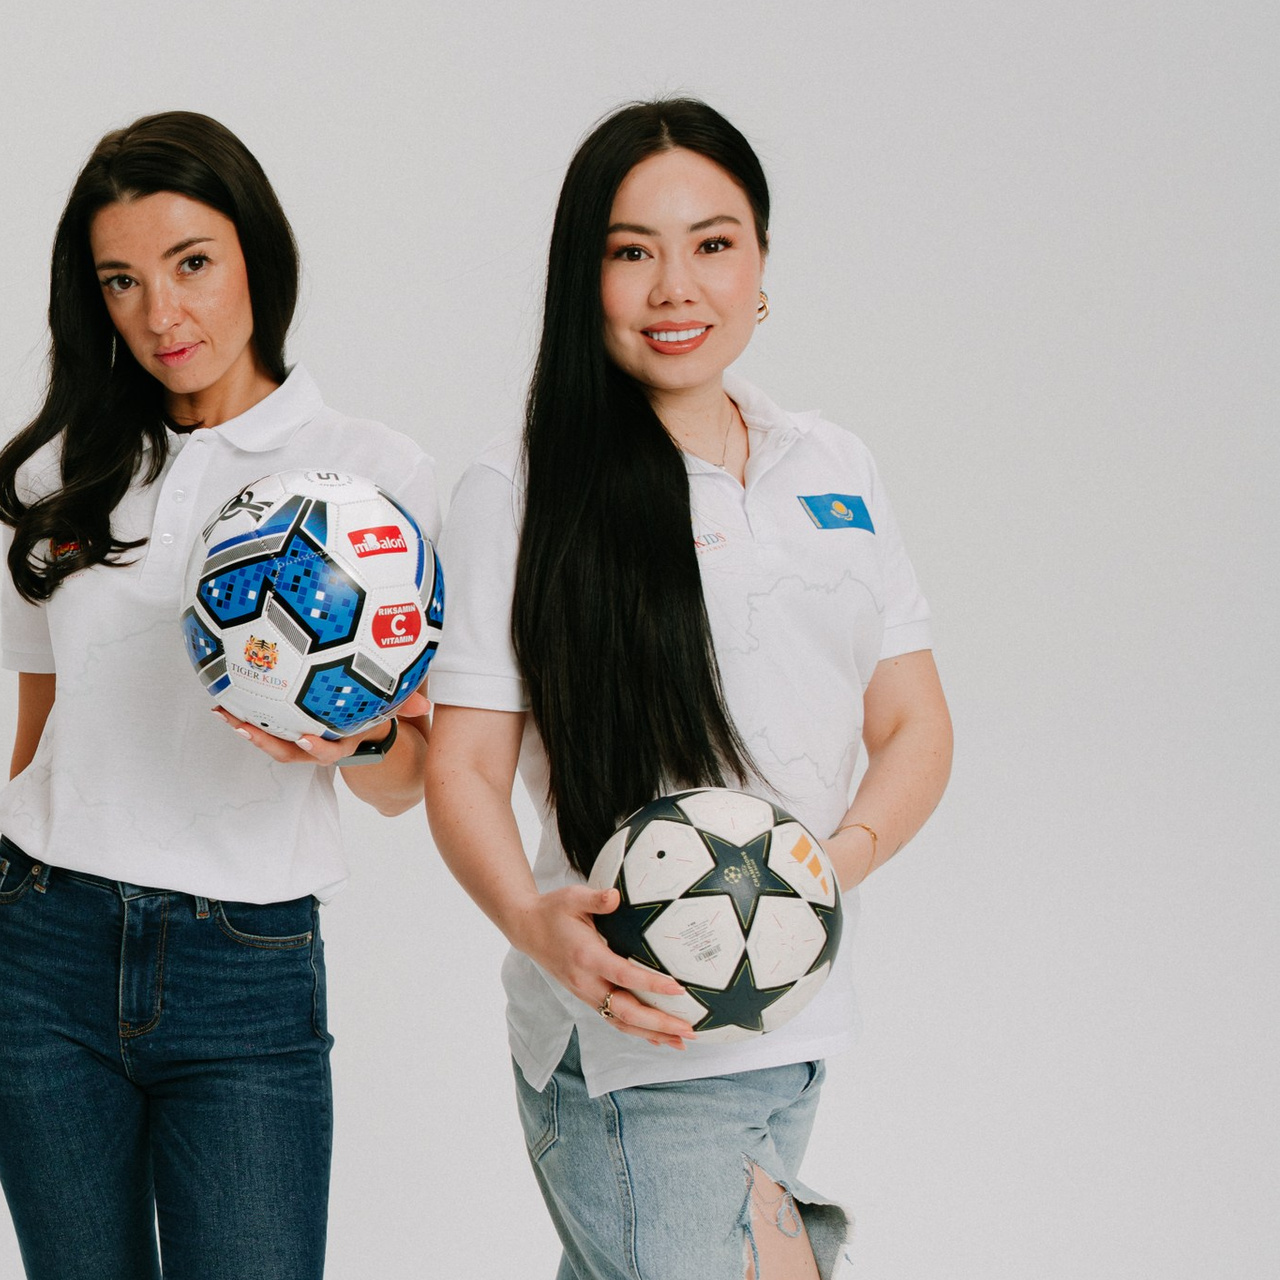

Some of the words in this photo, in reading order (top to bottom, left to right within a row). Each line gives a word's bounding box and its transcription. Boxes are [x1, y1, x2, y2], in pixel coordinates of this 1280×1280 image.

[378, 605, 416, 616] RIKSAMIN
[390, 614, 407, 636] C
[381, 634, 414, 645] VITAMIN
[231, 662, 260, 680] TIGER
[262, 674, 288, 688] KIDS
